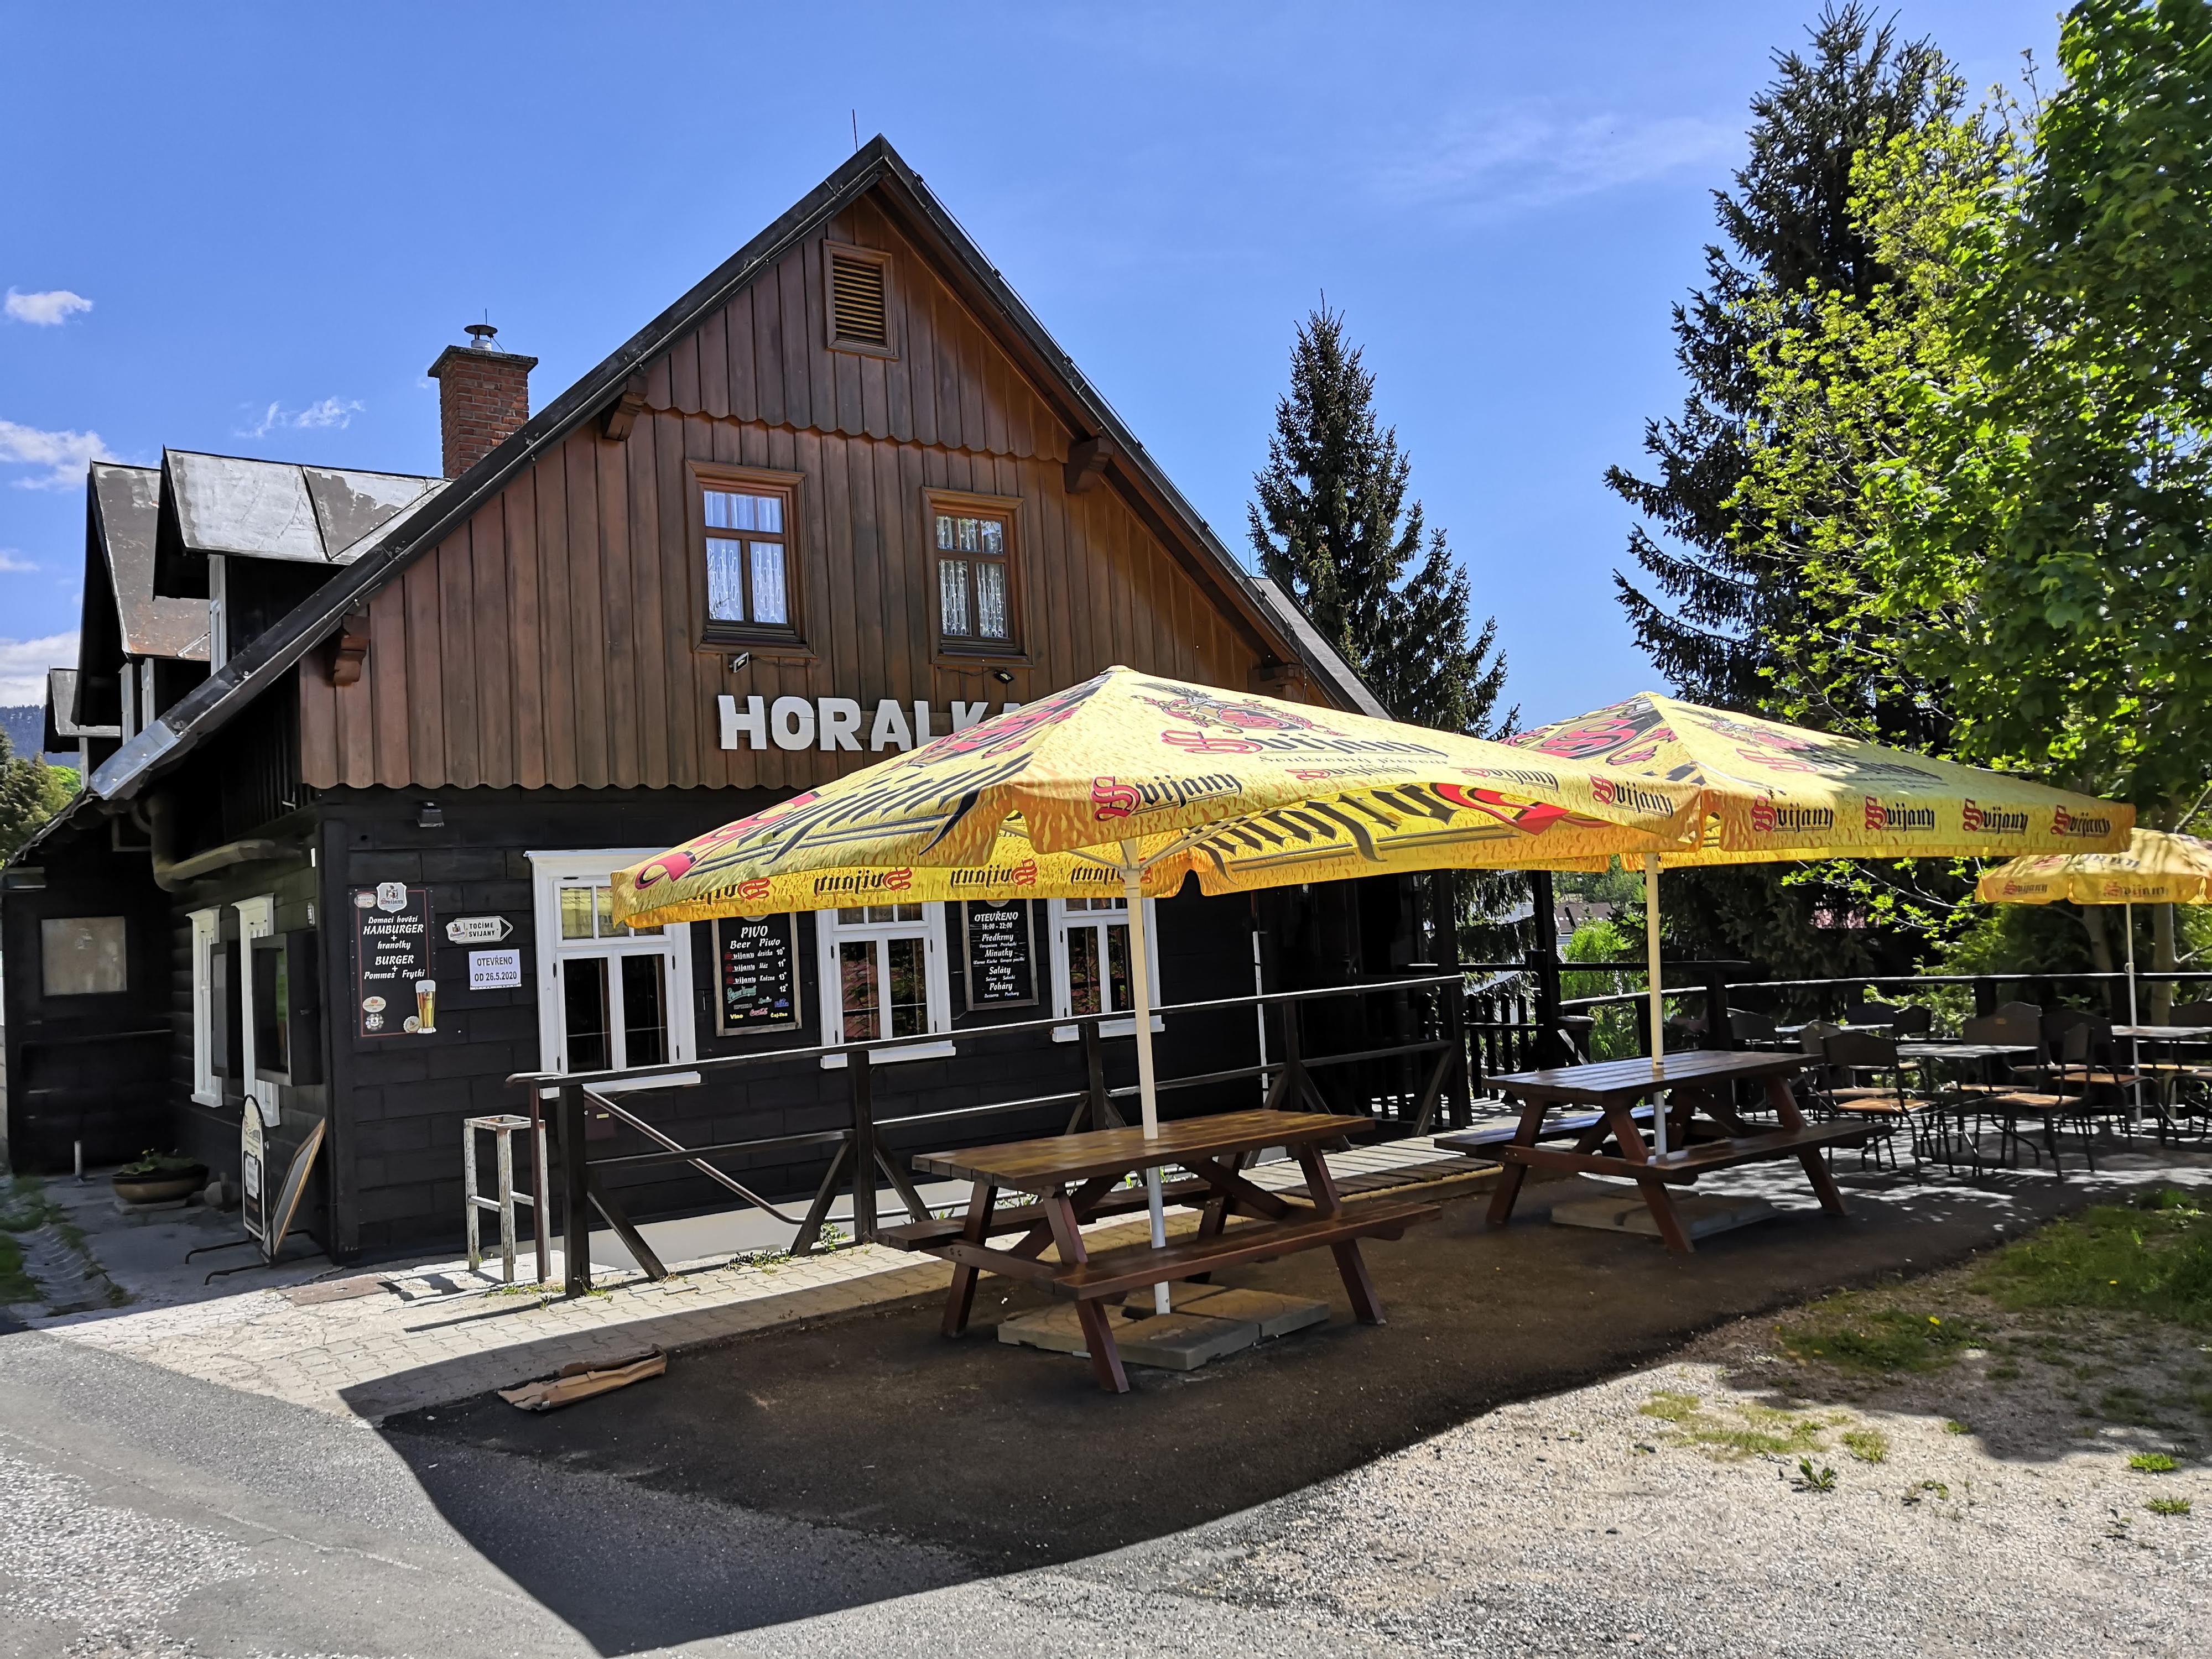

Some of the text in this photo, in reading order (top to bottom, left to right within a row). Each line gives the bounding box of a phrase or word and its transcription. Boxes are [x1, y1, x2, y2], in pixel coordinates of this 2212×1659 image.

[718, 695, 1023, 752] HORALK
[1091, 773, 1242, 822] Svijany
[1589, 773, 1673, 818] Svijany
[1751, 795, 1833, 833] Svijany
[1865, 795, 1935, 832] Svijany
[1963, 798, 2029, 836] Svijany
[2050, 805, 2111, 838] Svijany
[974, 911, 1018, 922] OTEVŘENO
[363, 924, 424, 935] HAMBURGER
[741, 925, 768, 938] PIVO
[982, 932, 1013, 942] Předkrmy
[377, 940, 411, 950] hranolky
[730, 938, 781, 950] Beer Piwo
[985, 947, 1013, 957] Minutky
[375, 954, 414, 966] BURGER
[477, 955, 513, 966] OTEVŘENO
[364, 969, 425, 979] Pommes Frytki
[989, 966, 1011, 975] Saláty
[475, 971, 517, 982] OD 26.5.2020
[990, 982, 1013, 991] Poháry
